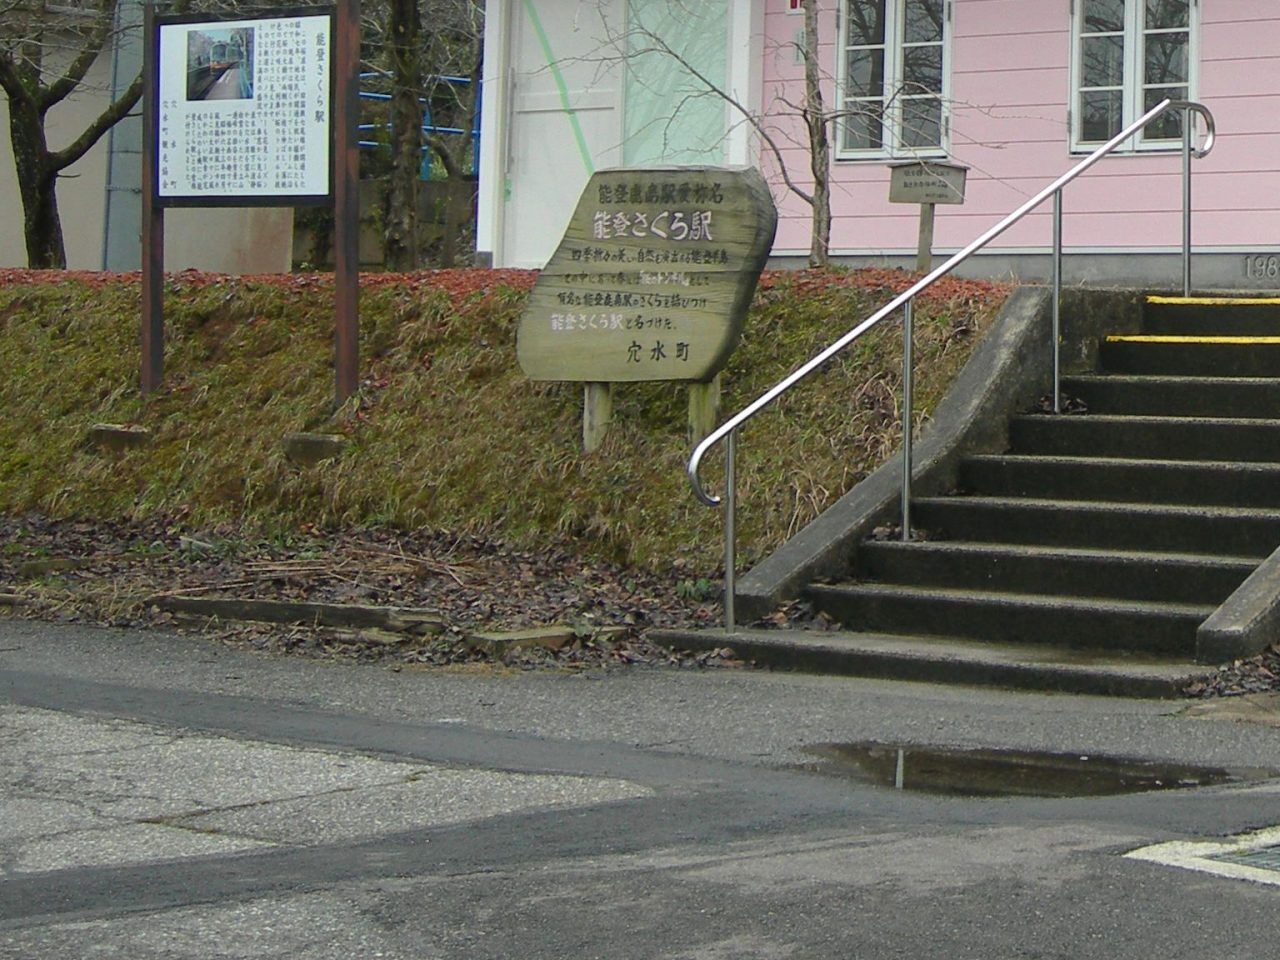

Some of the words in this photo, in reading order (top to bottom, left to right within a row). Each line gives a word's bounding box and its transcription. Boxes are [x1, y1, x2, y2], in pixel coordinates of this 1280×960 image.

[314, 33, 326, 123] 能登さくら駅
[592, 211, 713, 241] 能登さくら駅
[627, 341, 690, 364] 穴水町
